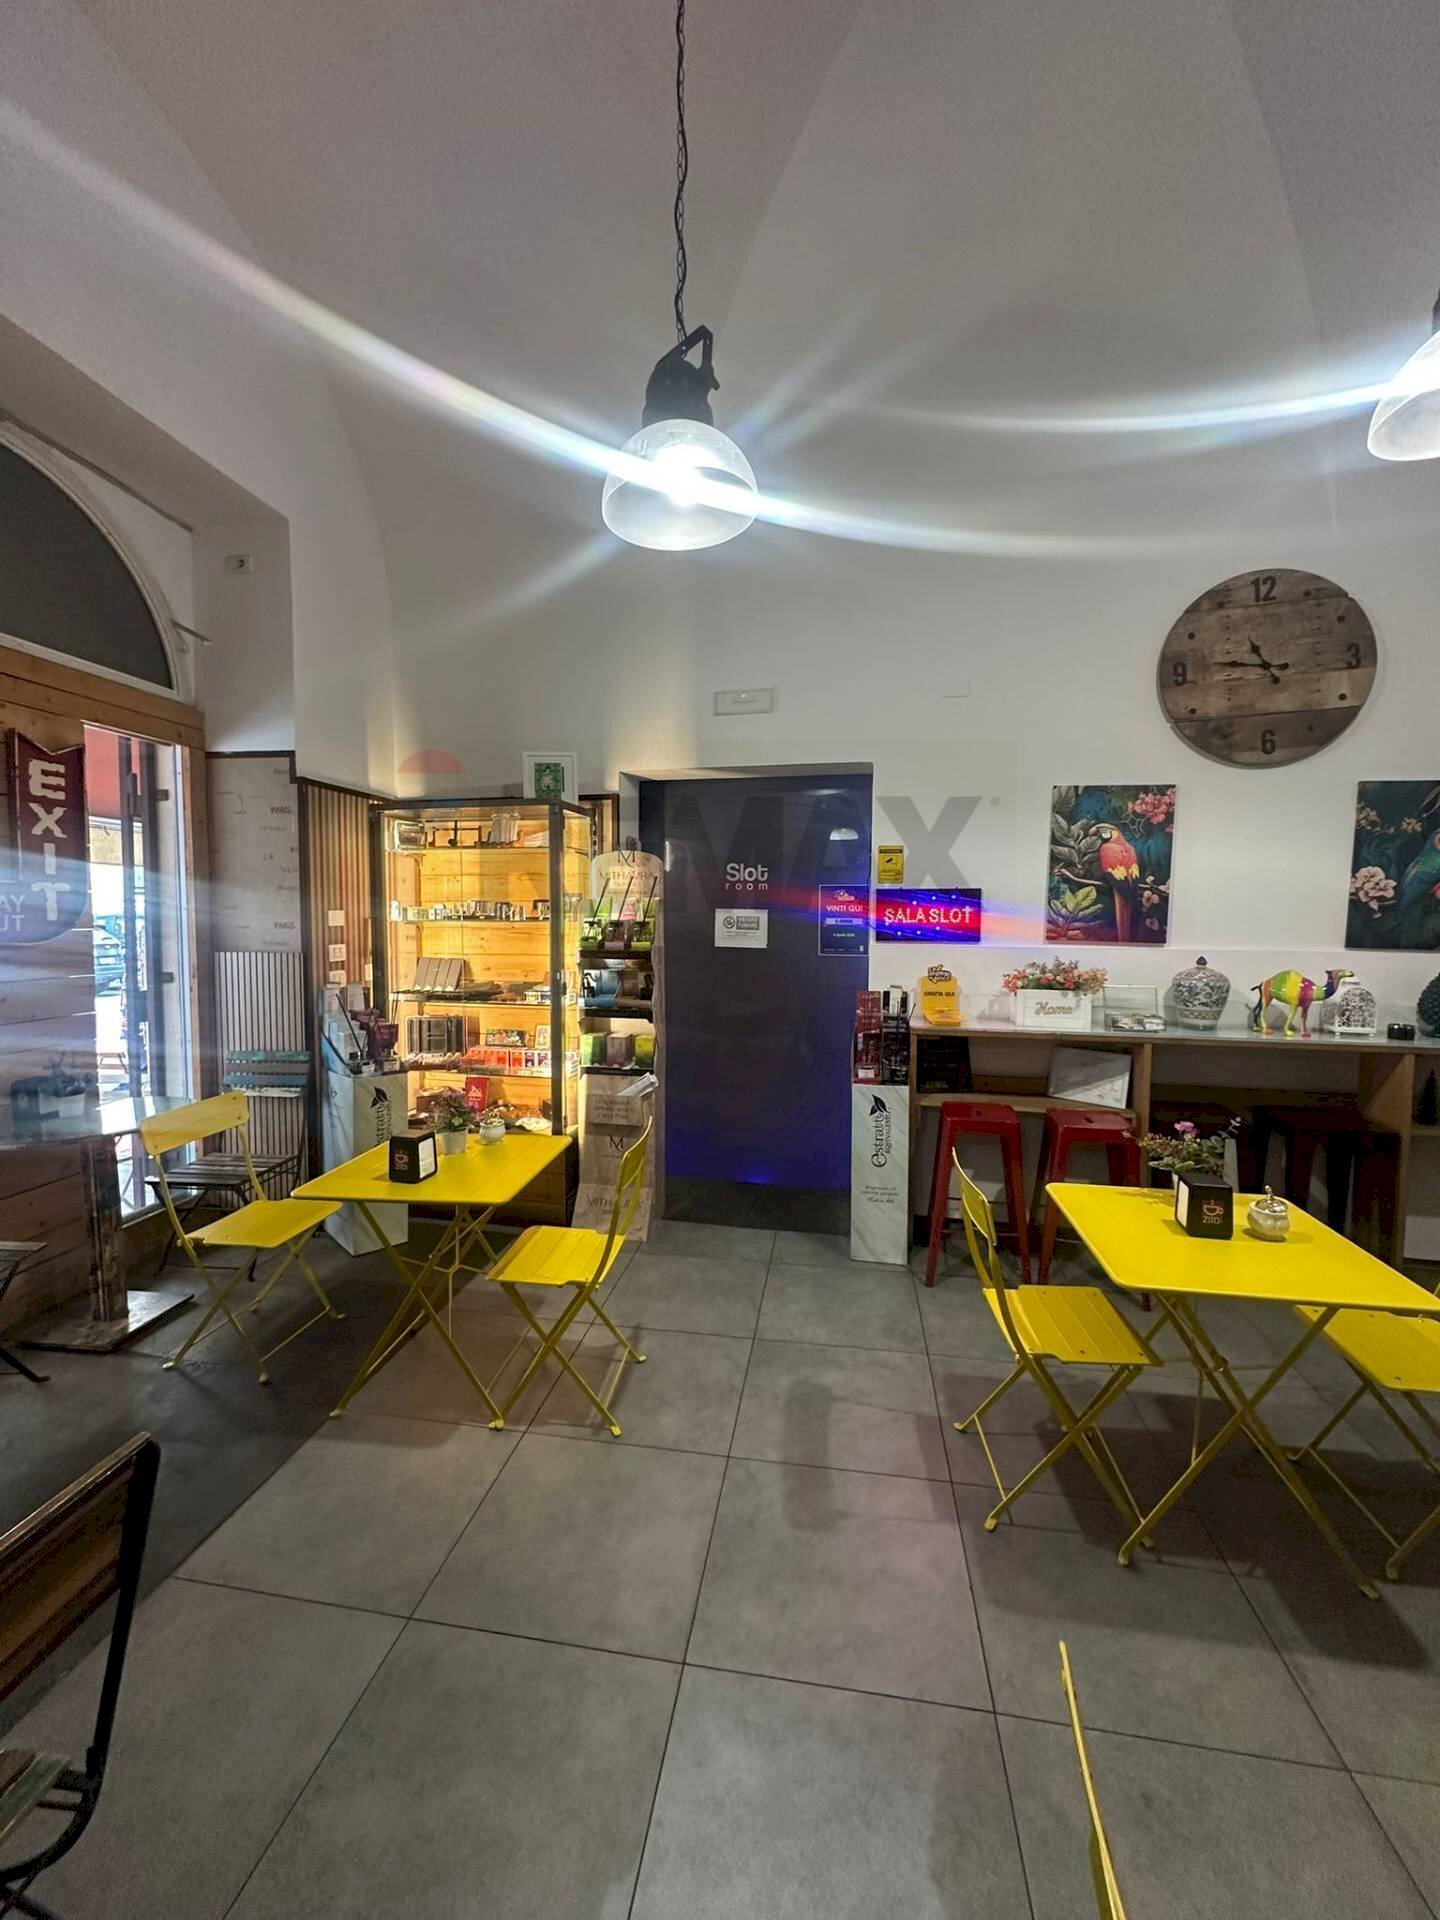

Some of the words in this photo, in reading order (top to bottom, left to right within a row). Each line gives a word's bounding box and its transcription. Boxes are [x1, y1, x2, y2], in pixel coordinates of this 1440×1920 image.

[1250, 575, 1277, 602] 12
[1346, 643, 1362, 669] 3
[1173, 661, 1188, 686] 9
[1260, 729, 1276, 755] 6
[28, 758, 72, 921] EXIT
[726, 862, 768, 881] Slot
[826, 904, 847, 912] VINTI
[848, 904, 863, 912] QUI
[884, 907, 927, 924] SALA
[928, 905, 973, 924] SLOT
[1034, 1001, 1073, 1015] Home
